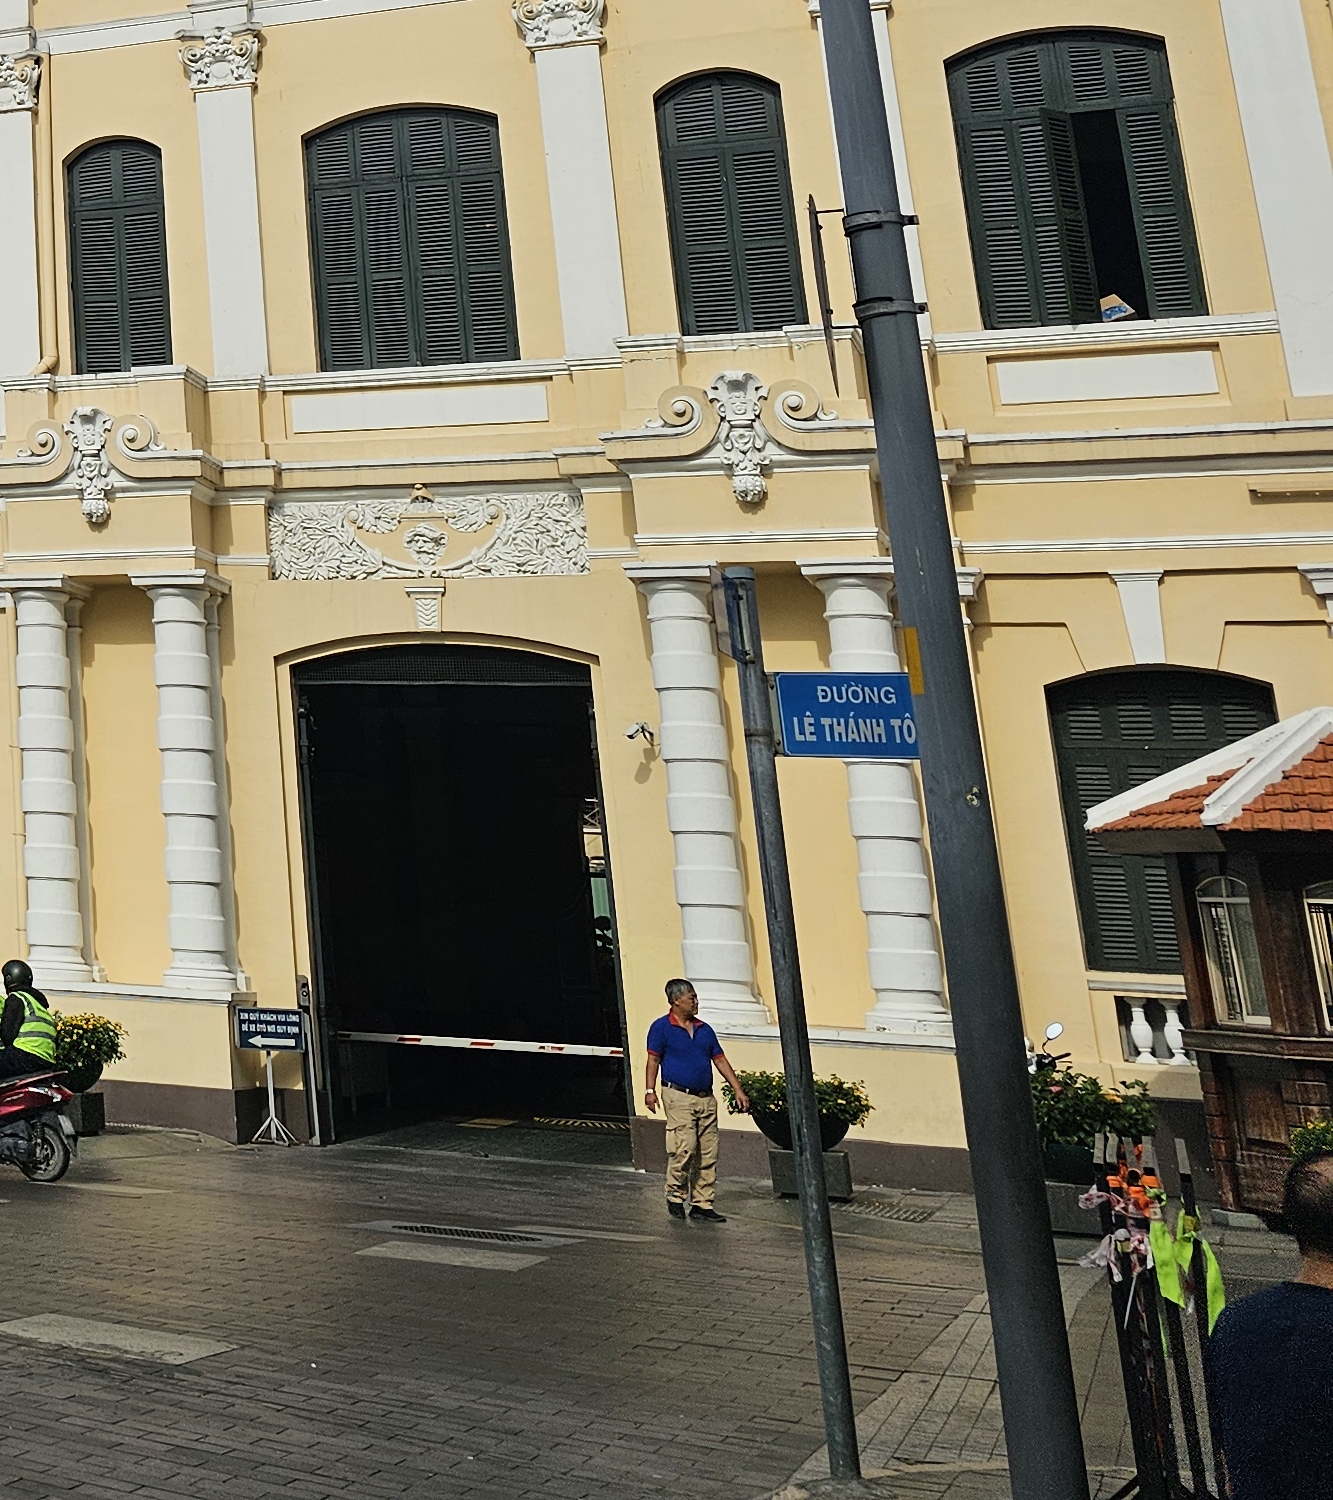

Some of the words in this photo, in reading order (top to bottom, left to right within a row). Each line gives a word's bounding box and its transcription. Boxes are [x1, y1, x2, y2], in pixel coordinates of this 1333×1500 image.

[816, 681, 897, 705] ĐƯỜNG
[792, 710, 817, 742] LÊ
[820, 711, 887, 743] THÁNH
[240, 1012, 249, 1020] XIN
[249, 1011, 260, 1020] QUÝ
[260, 1012, 277, 1021] KHÁCH
[277, 1014, 286, 1022] VUI
[249, 1024, 256, 1032] XE
